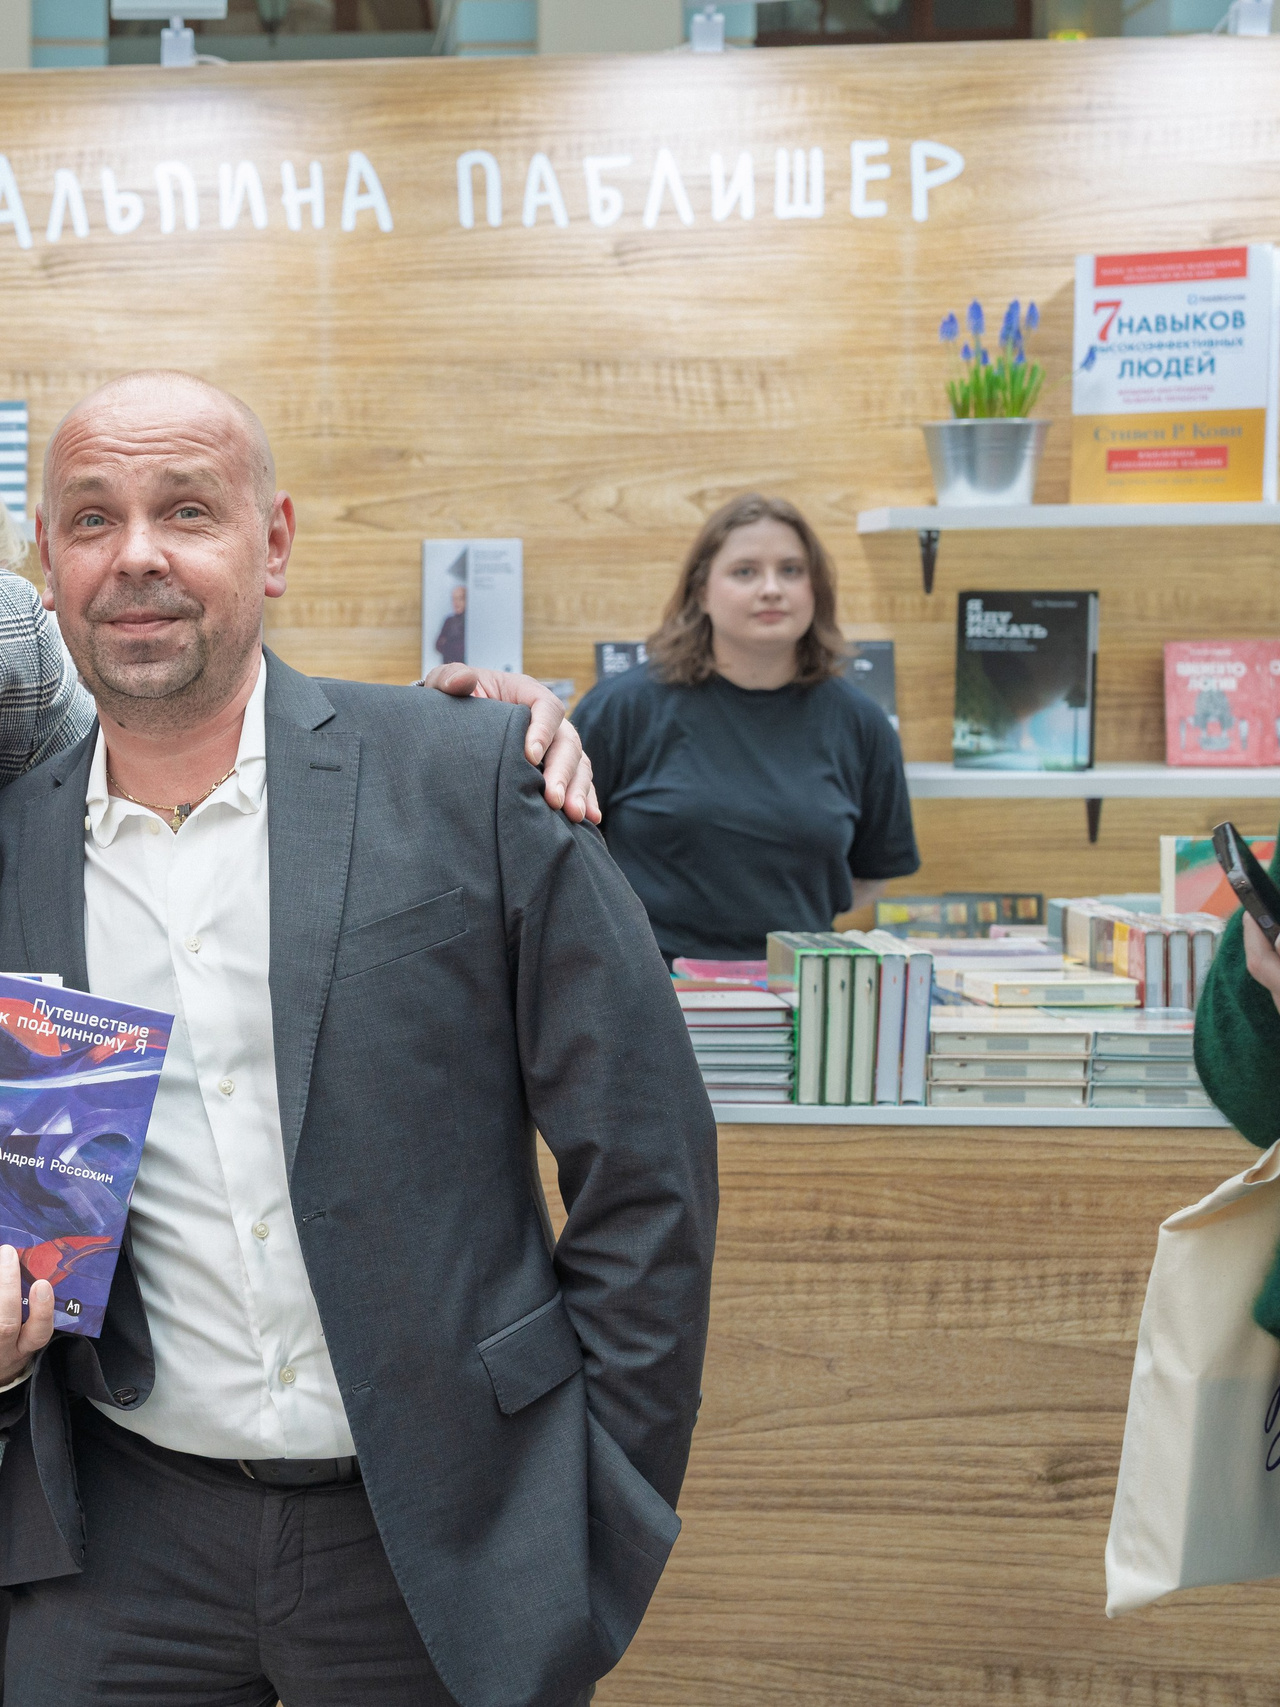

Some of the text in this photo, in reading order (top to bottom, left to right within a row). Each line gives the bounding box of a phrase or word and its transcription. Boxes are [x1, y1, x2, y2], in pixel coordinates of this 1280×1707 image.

[1093, 300, 1245, 342] 7 НАВЫКОВ
[1117, 350, 1216, 380] ЛЮДЕЙ
[16, 1016, 127, 1054] подлинному
[133, 1038, 148, 1055] Я
[32, 998, 150, 1039] Путешествие
[50, 1158, 114, 1184] Россохин
